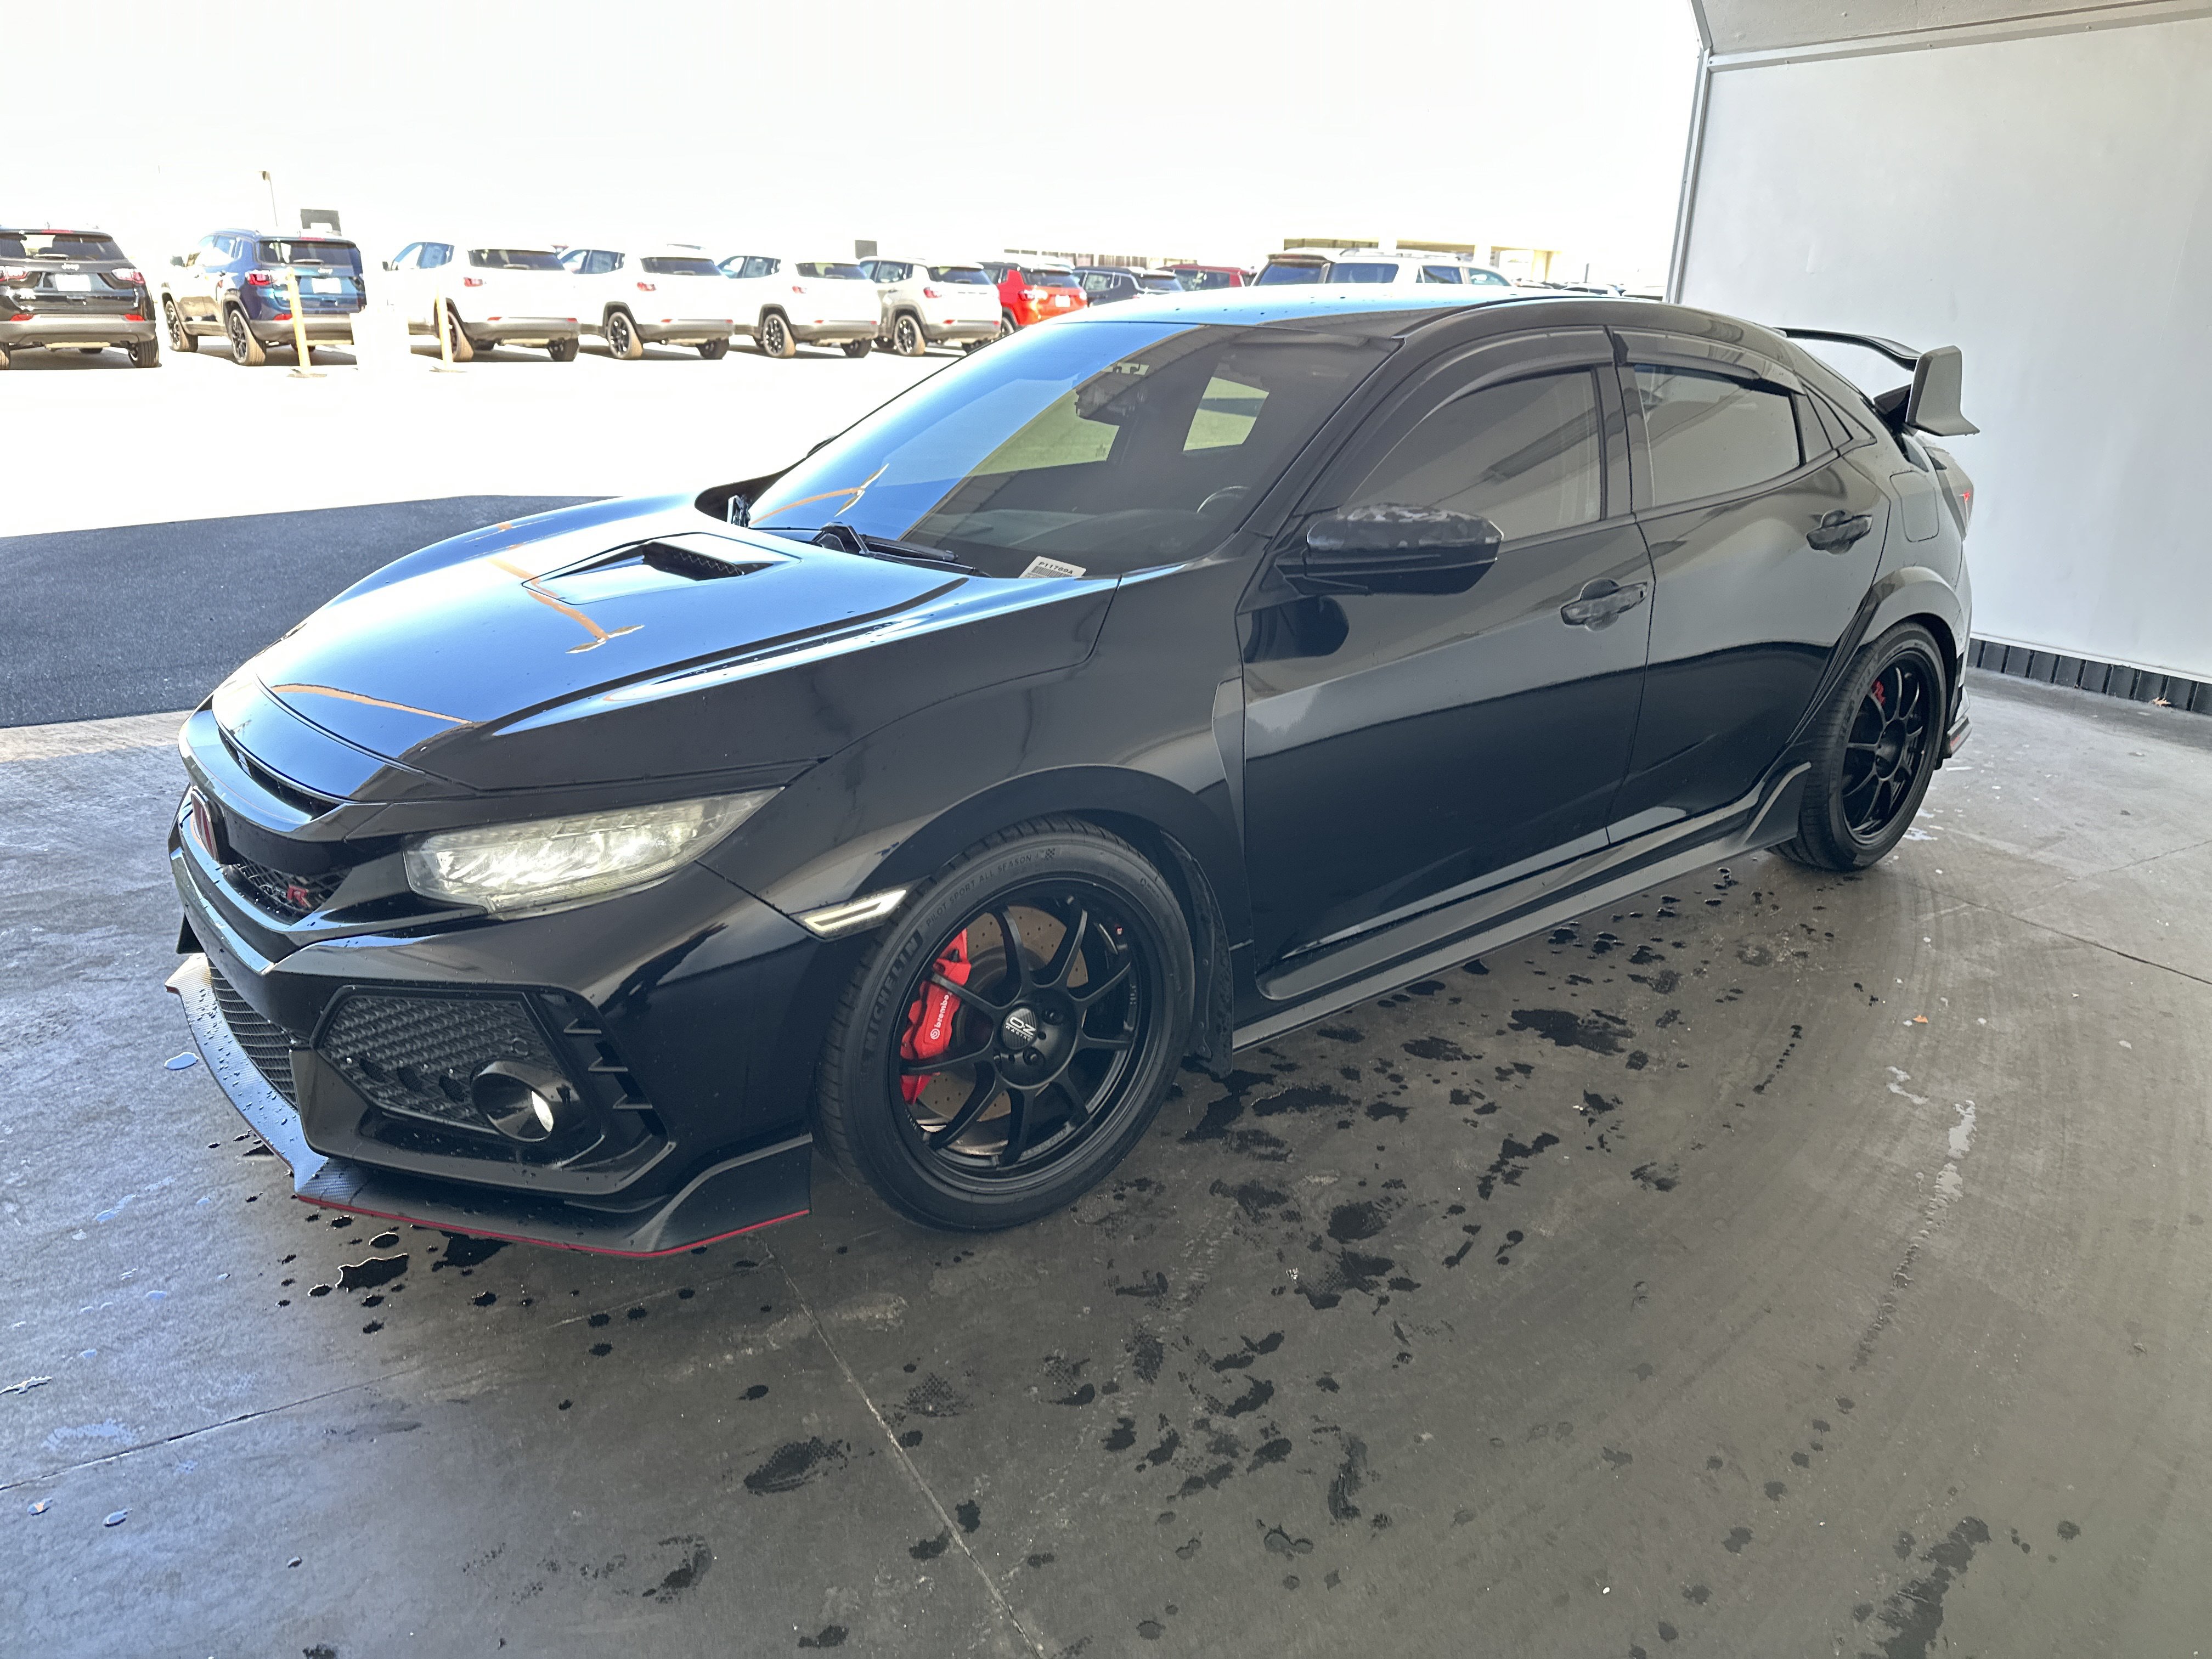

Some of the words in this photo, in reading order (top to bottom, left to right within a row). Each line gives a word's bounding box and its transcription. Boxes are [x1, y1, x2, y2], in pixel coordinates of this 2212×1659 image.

[287, 884, 309, 907] R
[926, 902, 947, 927] PILOT
[949, 880, 975, 905] SPORT
[979, 870, 993, 883] ALL
[997, 854, 1031, 872] SEASON
[865, 932, 921, 1050] MICHELIN
[934, 995, 949, 1028] brembo
[1006, 1025, 1031, 1041] RACING
